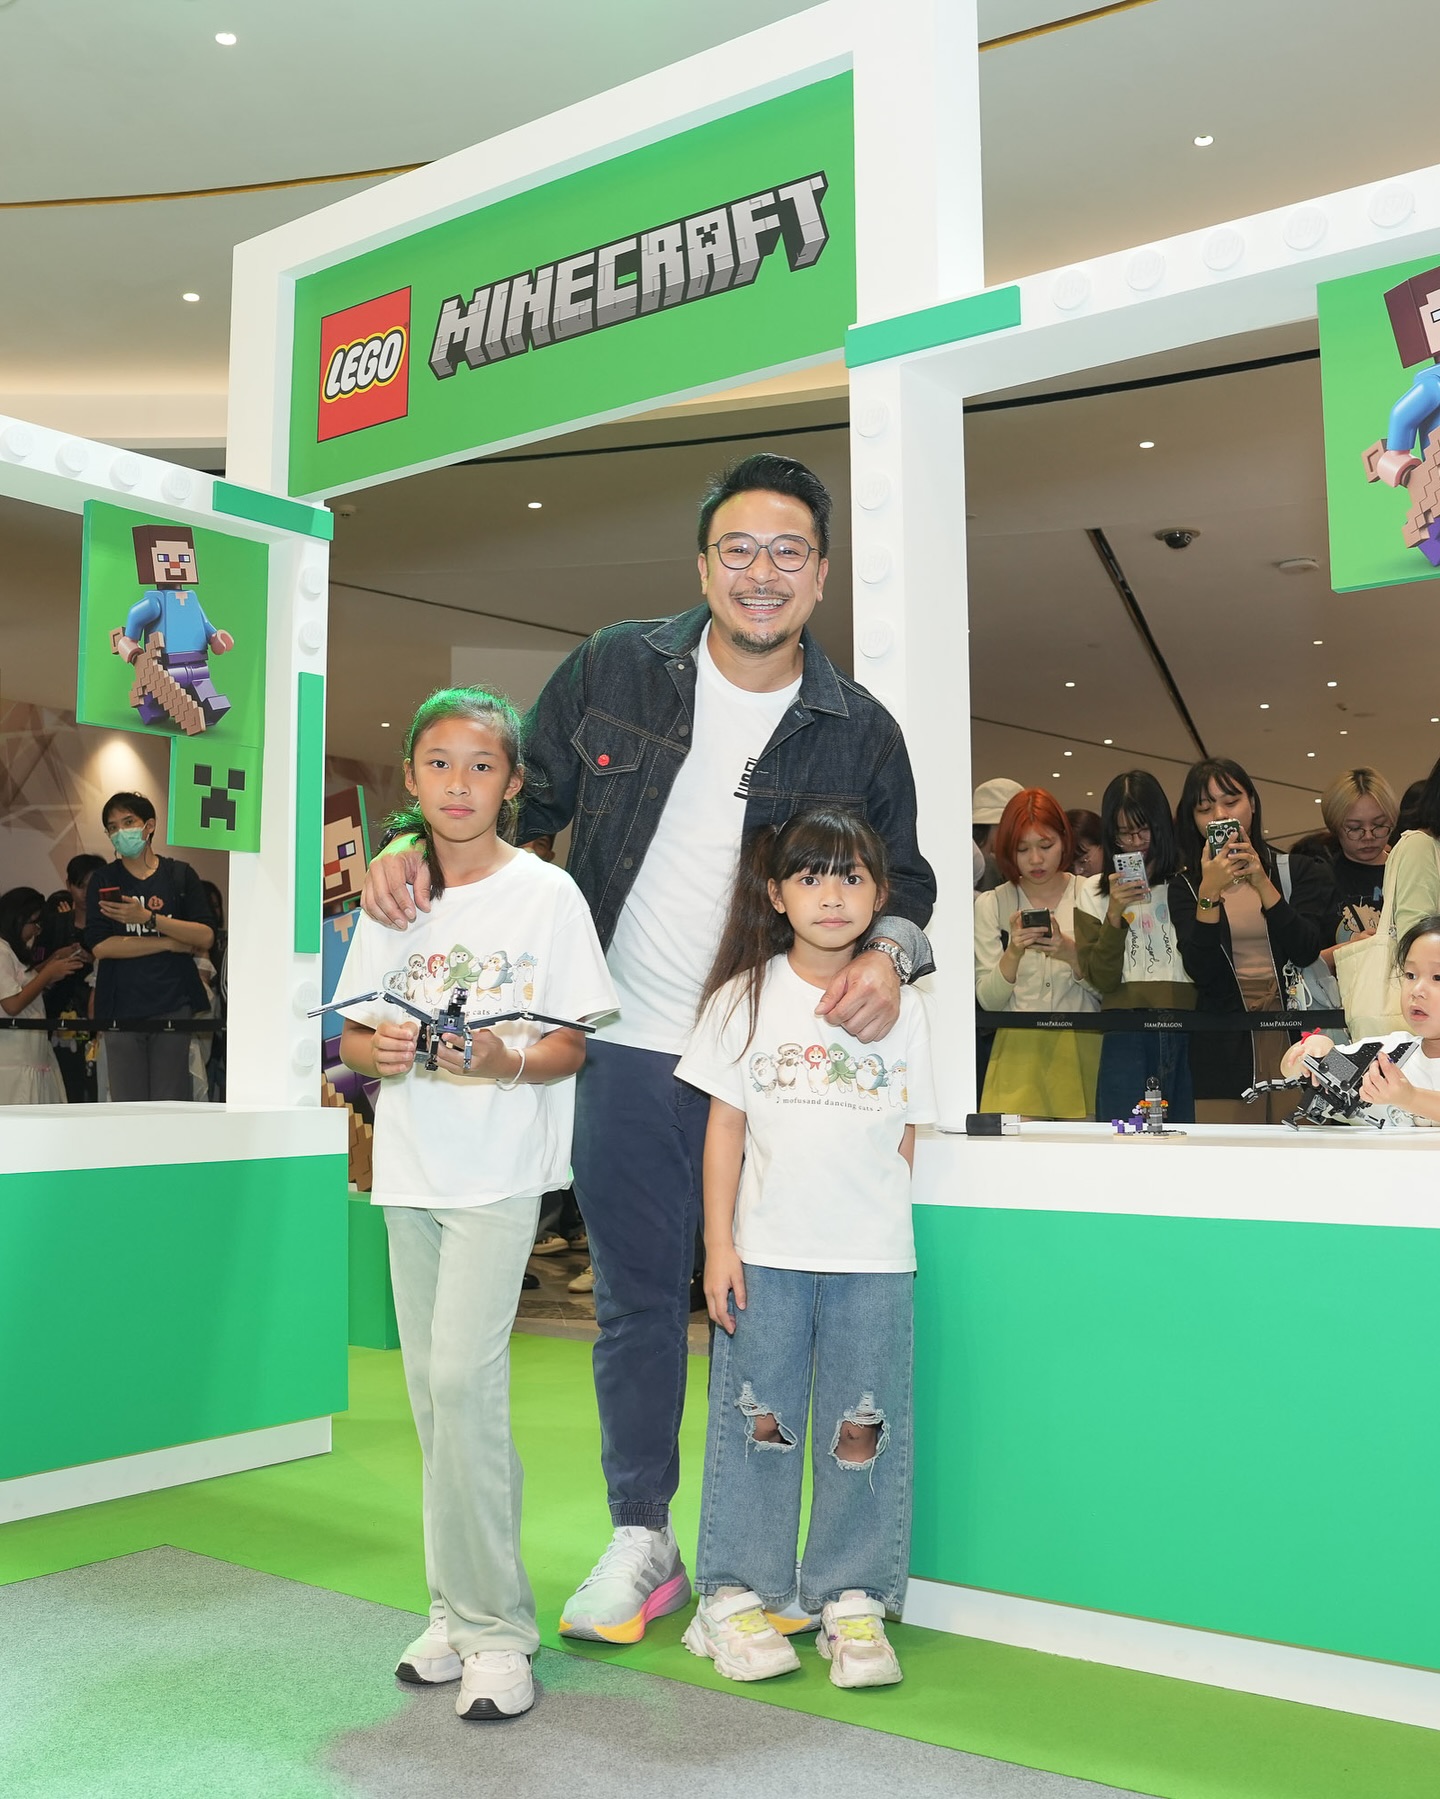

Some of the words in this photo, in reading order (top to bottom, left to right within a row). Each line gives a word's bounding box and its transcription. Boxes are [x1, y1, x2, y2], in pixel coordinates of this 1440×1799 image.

[324, 328, 405, 399] LEGO
[428, 171, 829, 380] MINECRAFT
[472, 1008, 491, 1016] cats
[782, 1097, 821, 1105] mofusand
[824, 1099, 857, 1110] dancing
